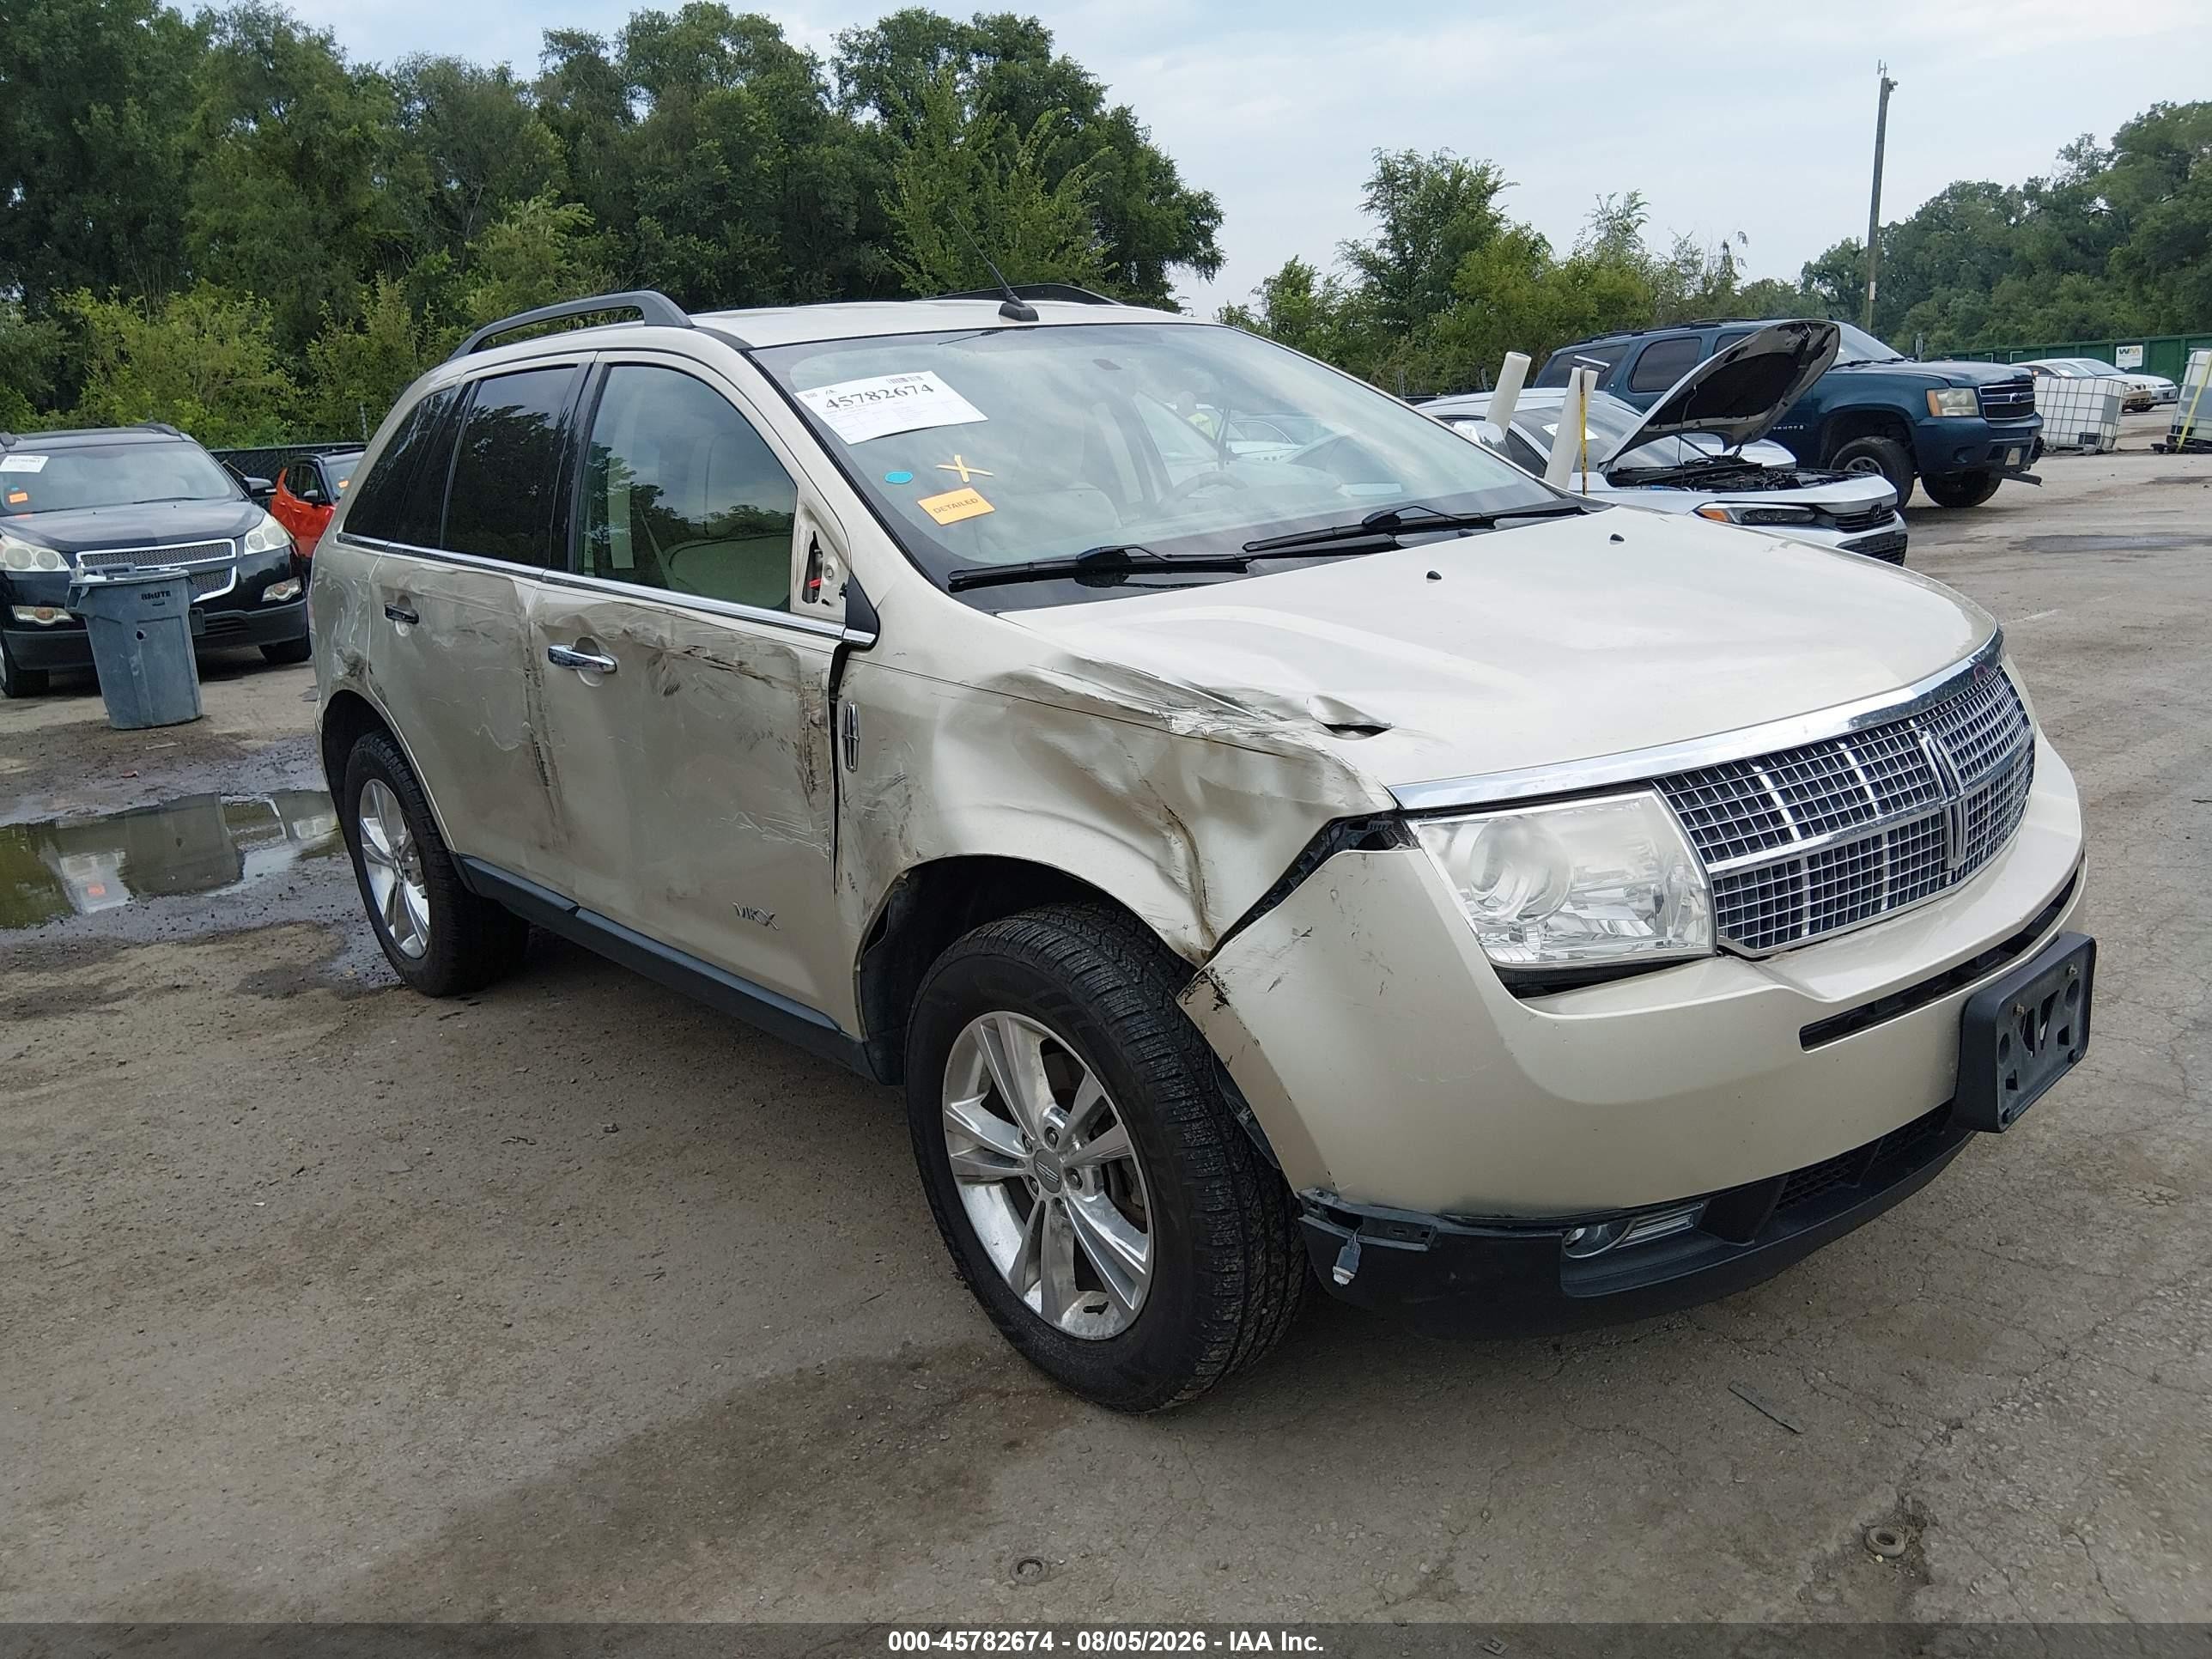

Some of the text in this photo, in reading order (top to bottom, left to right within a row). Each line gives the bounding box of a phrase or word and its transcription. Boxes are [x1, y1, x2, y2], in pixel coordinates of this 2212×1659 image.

[826, 384, 934, 409] 45782674
[933, 497, 979, 514] DETAILED
[141, 590, 171, 600] BRUTE
